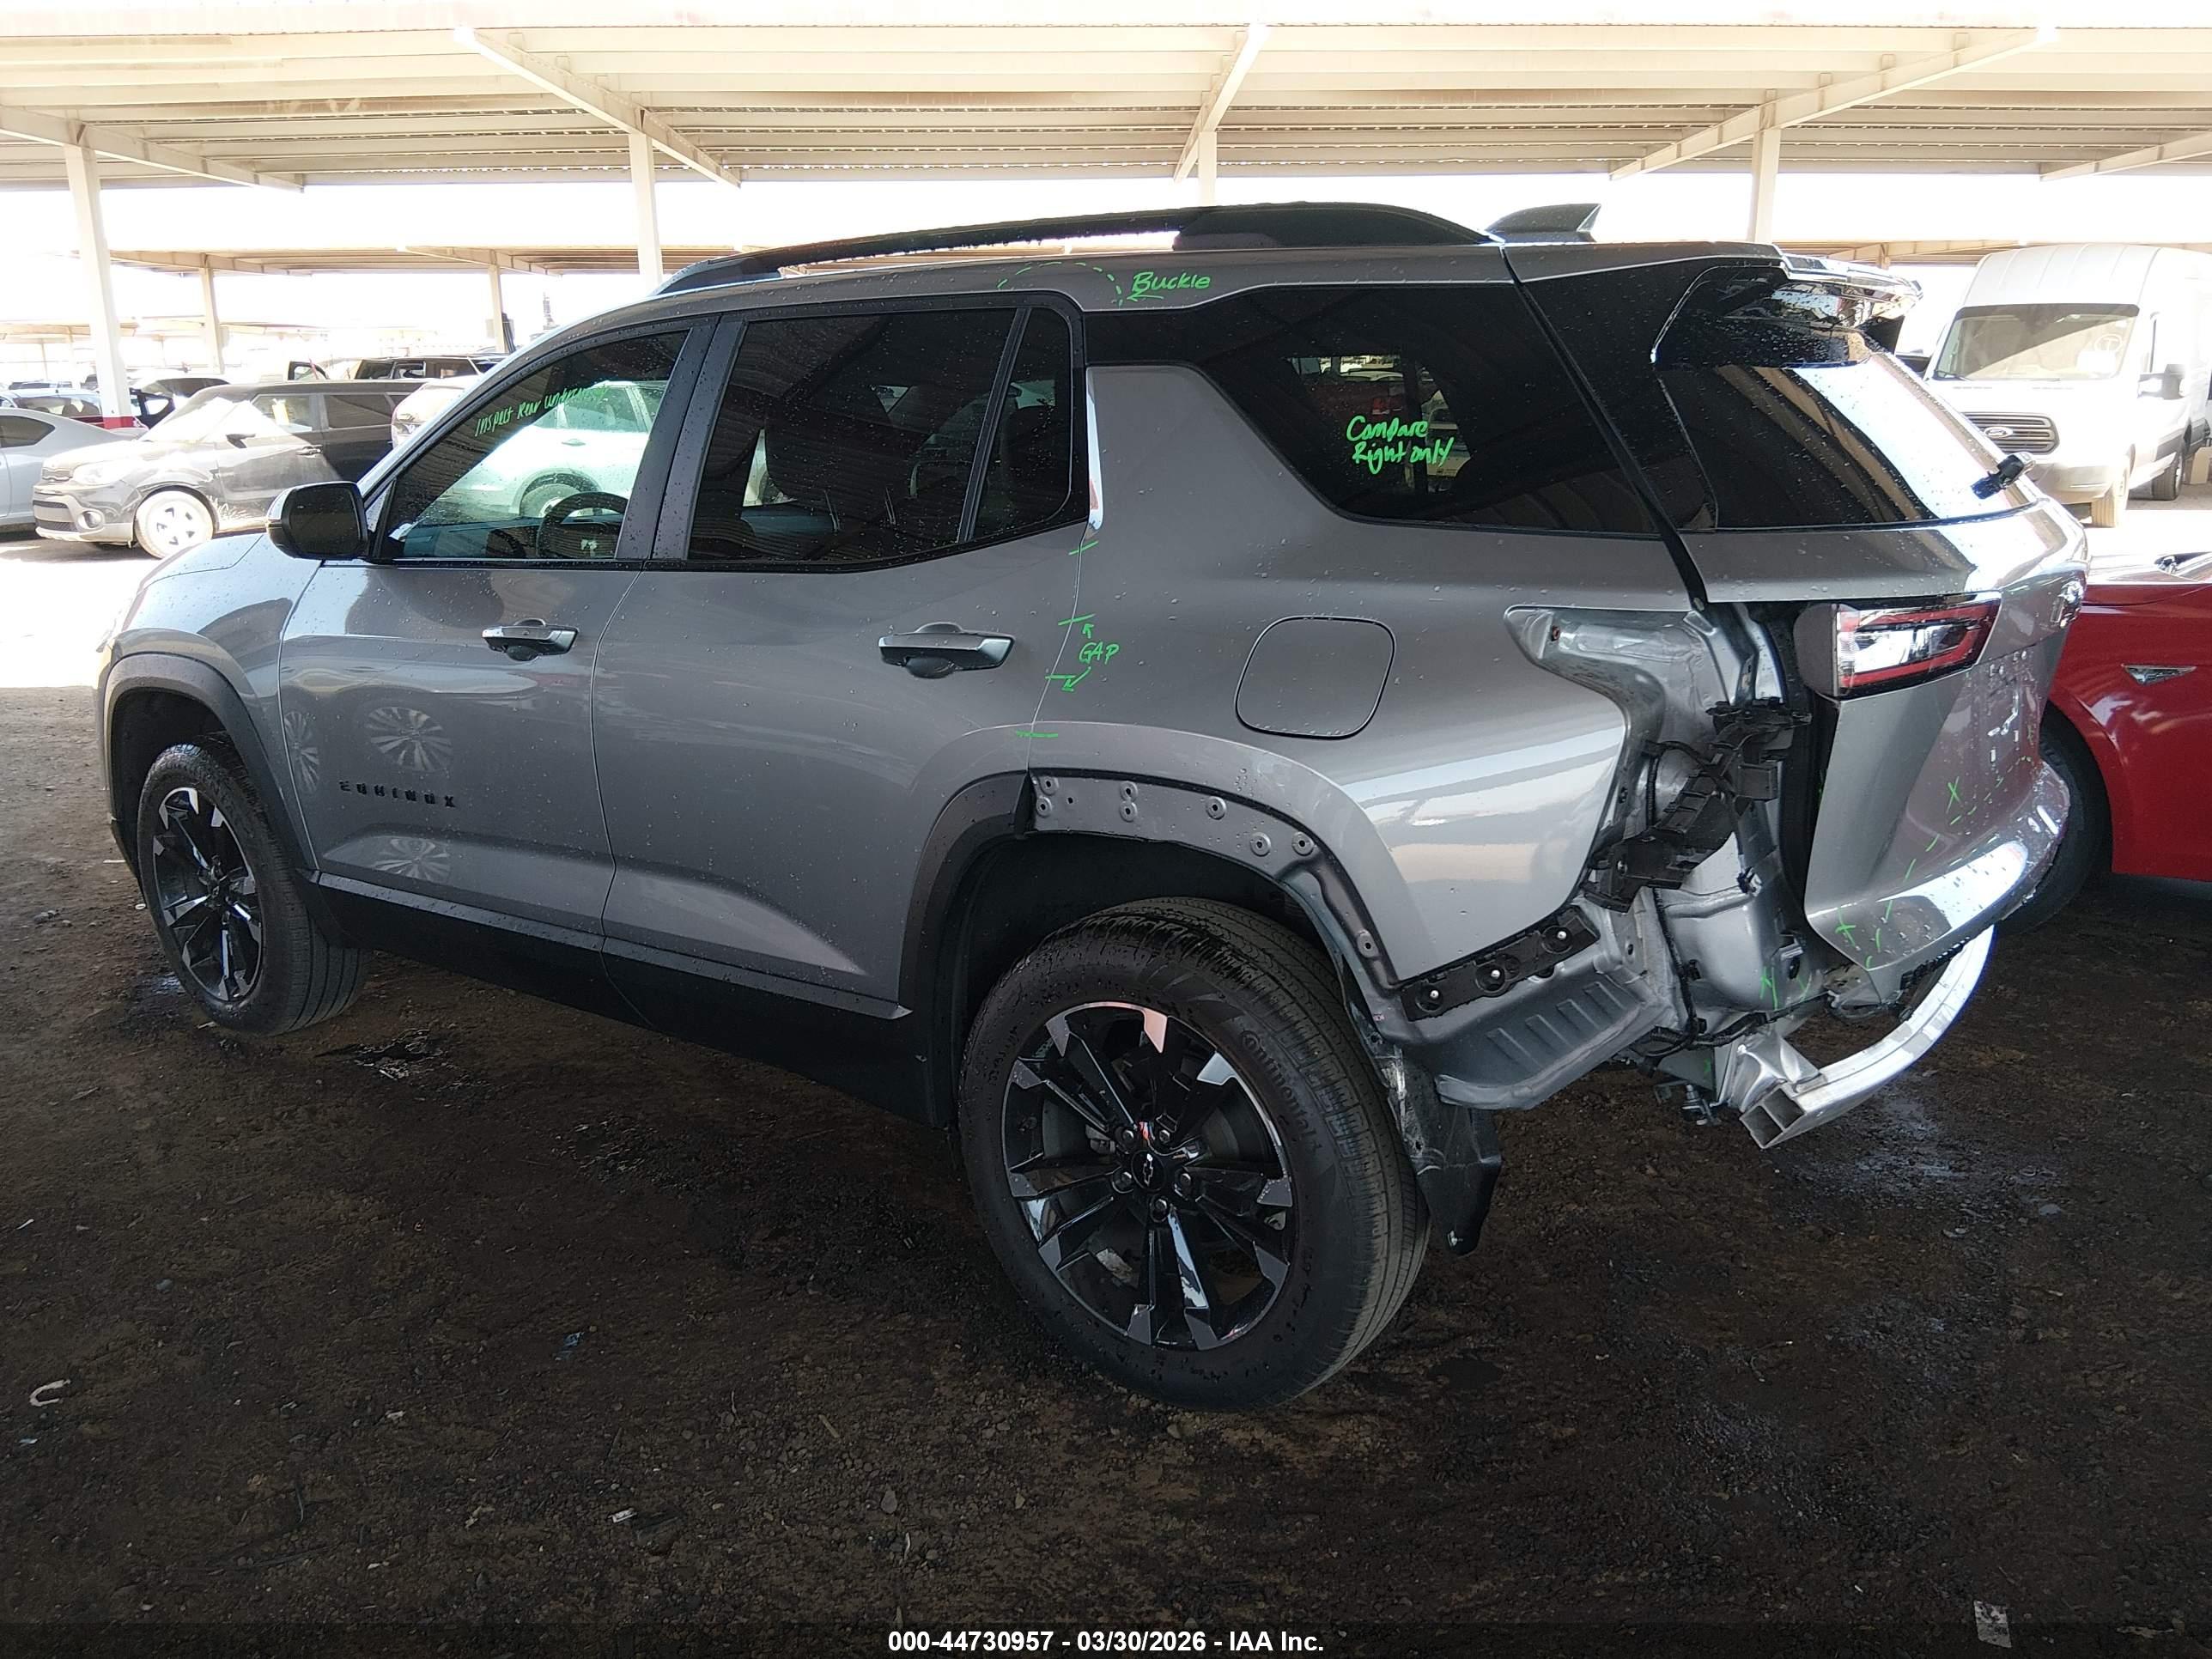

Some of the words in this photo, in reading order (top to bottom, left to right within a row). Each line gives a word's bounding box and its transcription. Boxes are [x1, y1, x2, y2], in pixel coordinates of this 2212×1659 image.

[1346, 415, 1429, 442] Compare
[1352, 441, 1407, 474] Right
[1079, 641, 1120, 665] GAP
